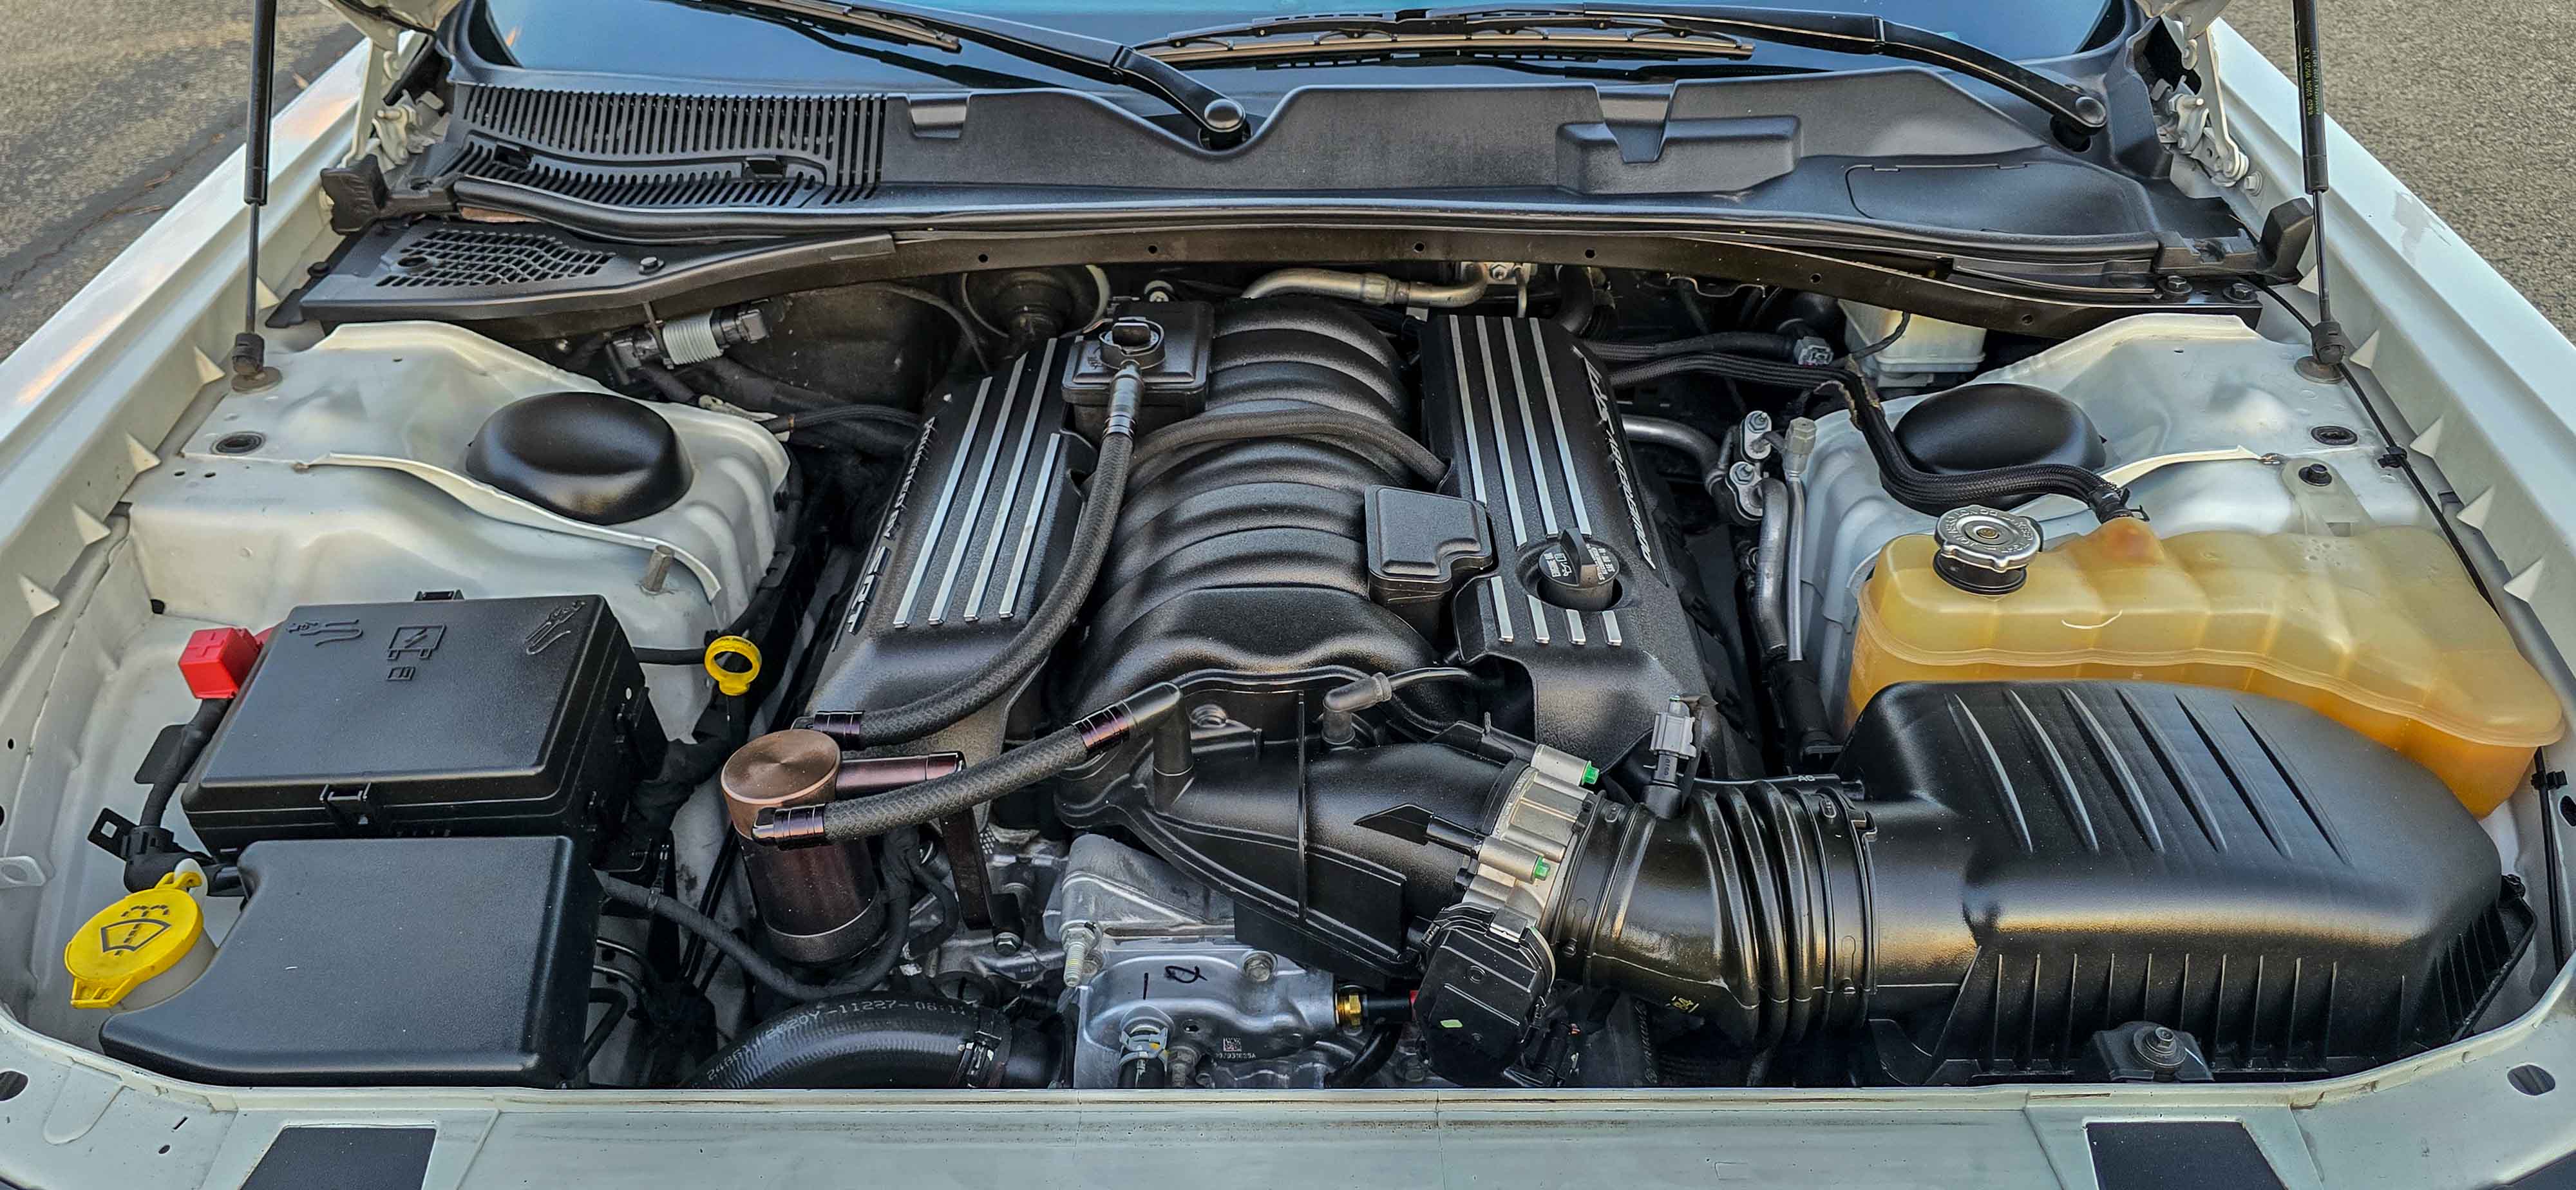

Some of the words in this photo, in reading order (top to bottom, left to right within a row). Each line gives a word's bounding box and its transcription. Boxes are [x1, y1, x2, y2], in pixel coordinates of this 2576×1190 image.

[1570, 345, 1615, 435] SRT
[1615, 459, 1656, 570] POWERED
[847, 546, 887, 634] SRT
